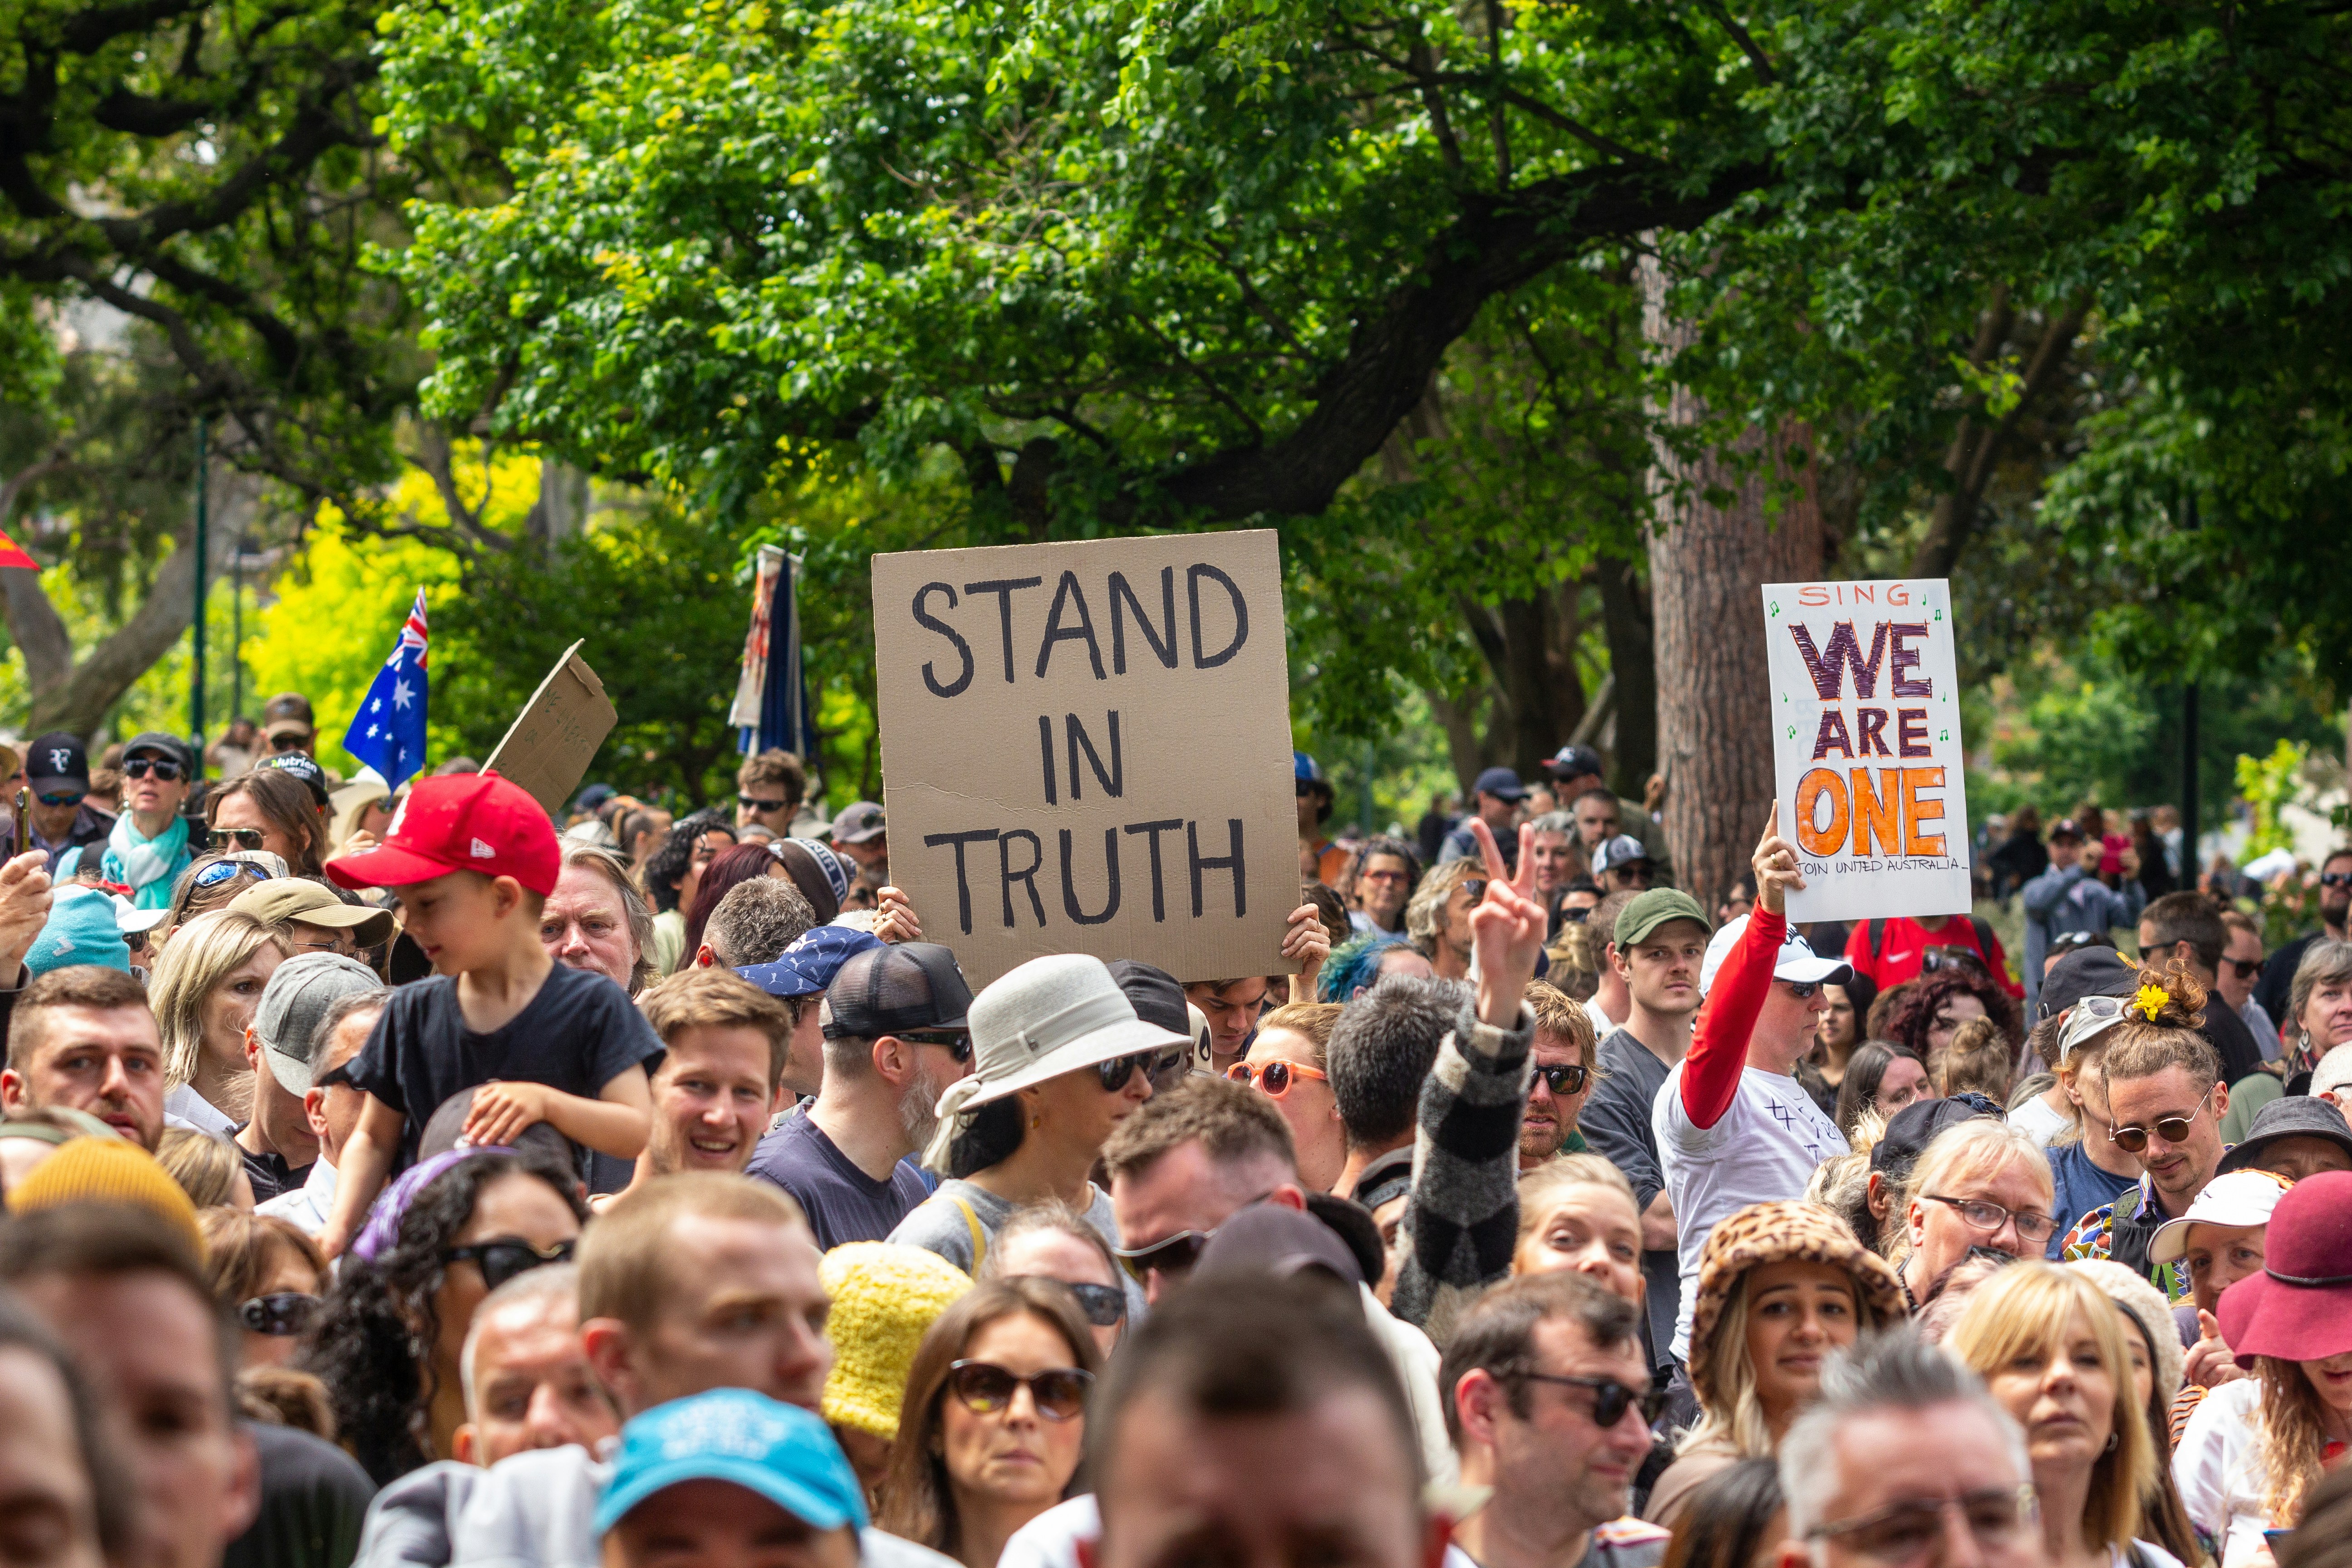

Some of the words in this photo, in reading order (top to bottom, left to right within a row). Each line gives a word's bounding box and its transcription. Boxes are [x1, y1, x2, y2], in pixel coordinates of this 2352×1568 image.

[912, 563, 1249, 698] STAND
[1798, 584, 1910, 606] SING
[1788, 618, 1933, 702] WE
[271, 756, 318, 773] Nutrien
[1038, 709, 1122, 806] IN
[1810, 706, 1933, 763] ARE
[1795, 765, 1950, 860] ONE
[924, 818, 1247, 936] TRUTH
[1836, 860, 1882, 874] UNITED
